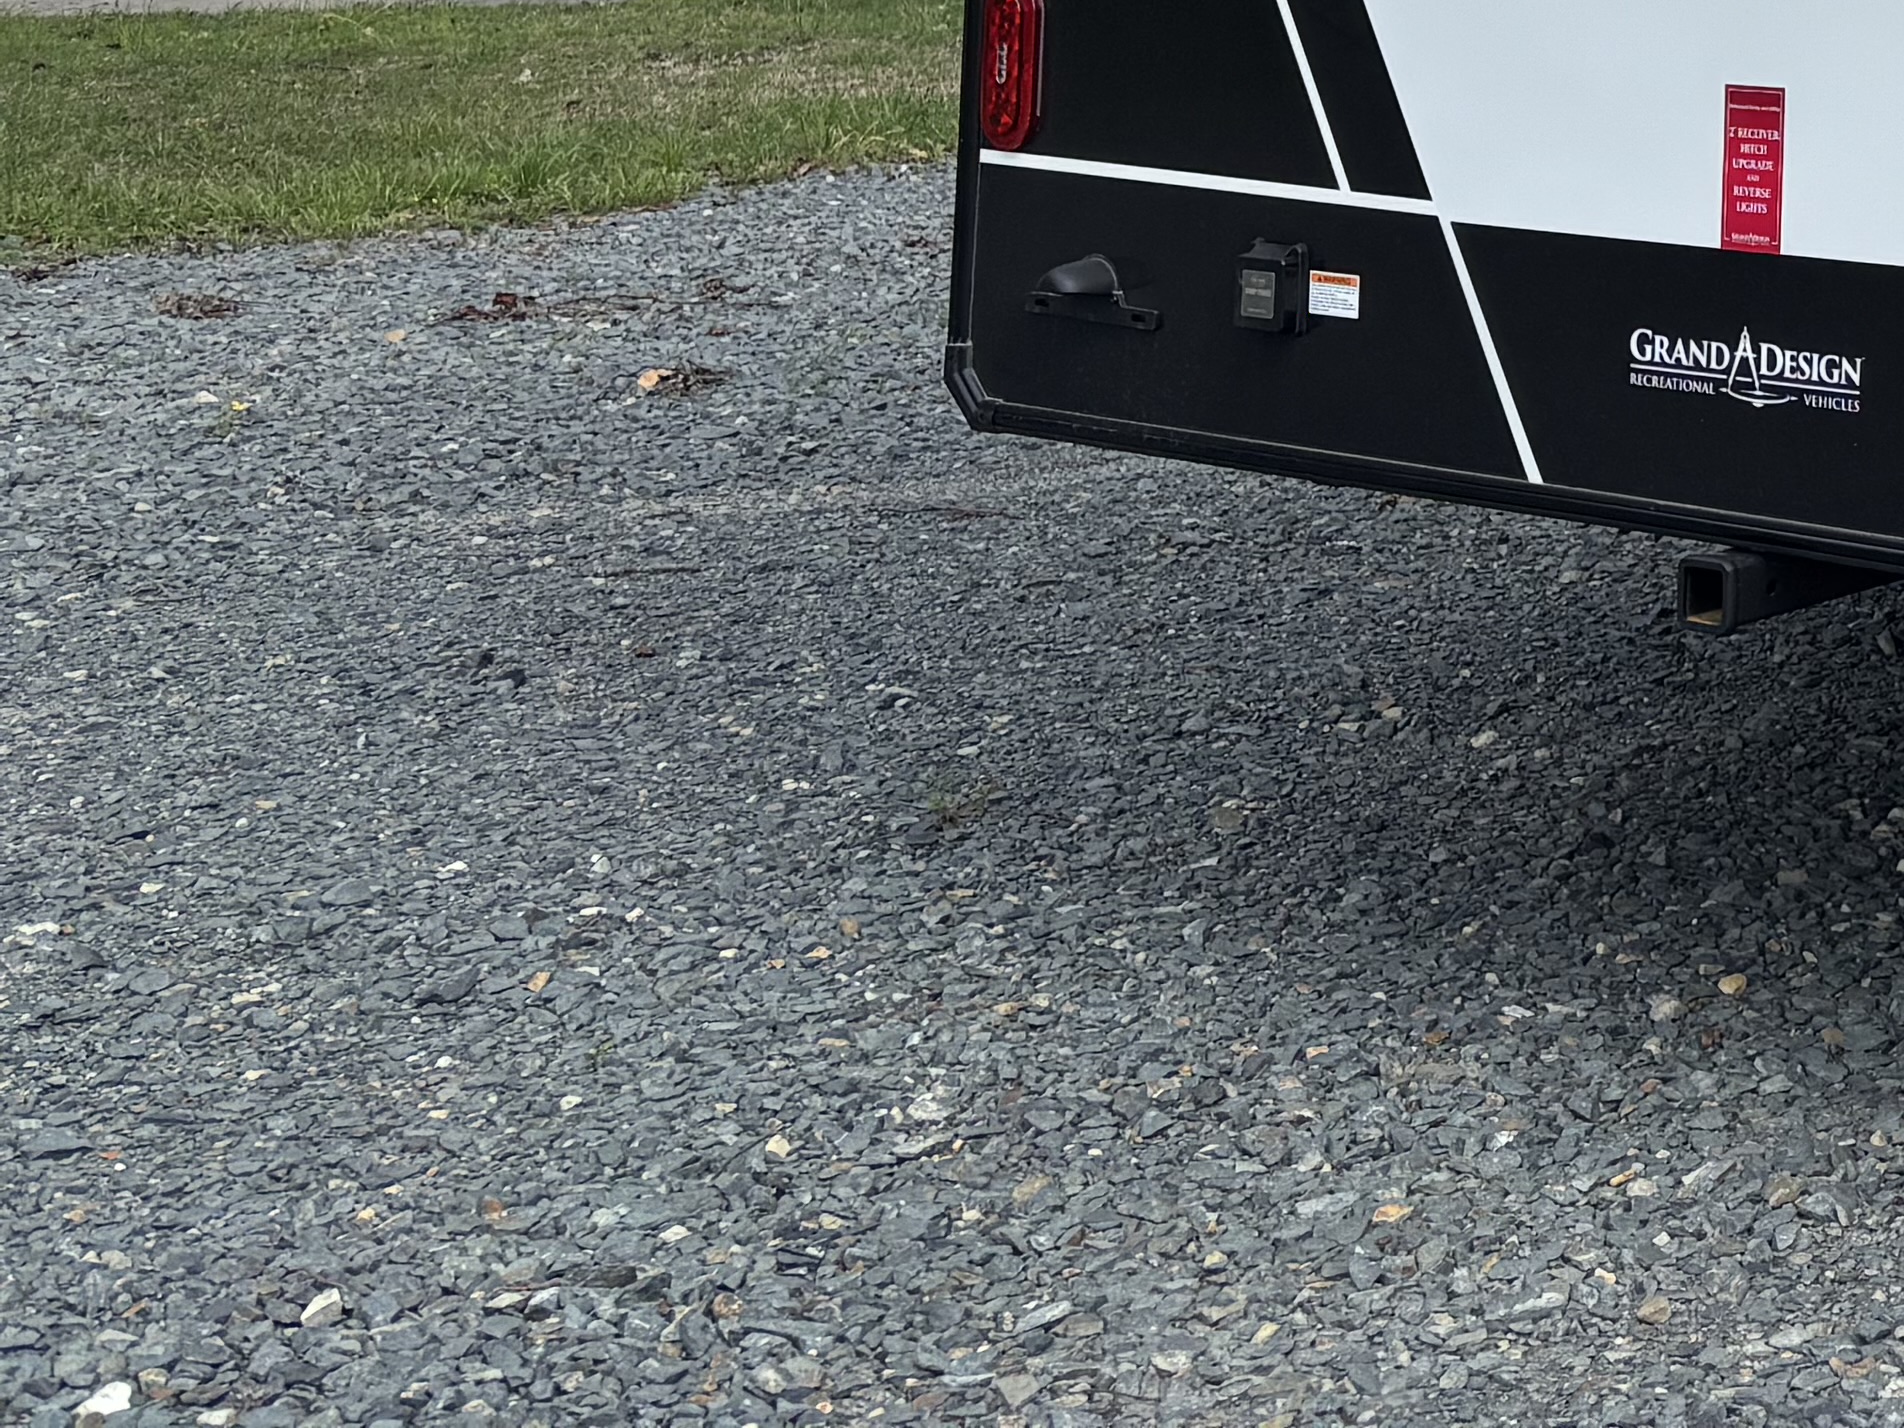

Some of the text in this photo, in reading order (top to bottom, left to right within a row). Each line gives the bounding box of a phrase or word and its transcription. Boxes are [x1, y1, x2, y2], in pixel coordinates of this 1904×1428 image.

[1732, 157, 1774, 171] UPGRADE
[1733, 185, 1772, 199] REVERSE
[1736, 201, 1768, 214] LIGHTS
[1630, 328, 1862, 387] GRAND DESIGN
[1629, 372, 1861, 412] RECREATIONAL VEHICLES
